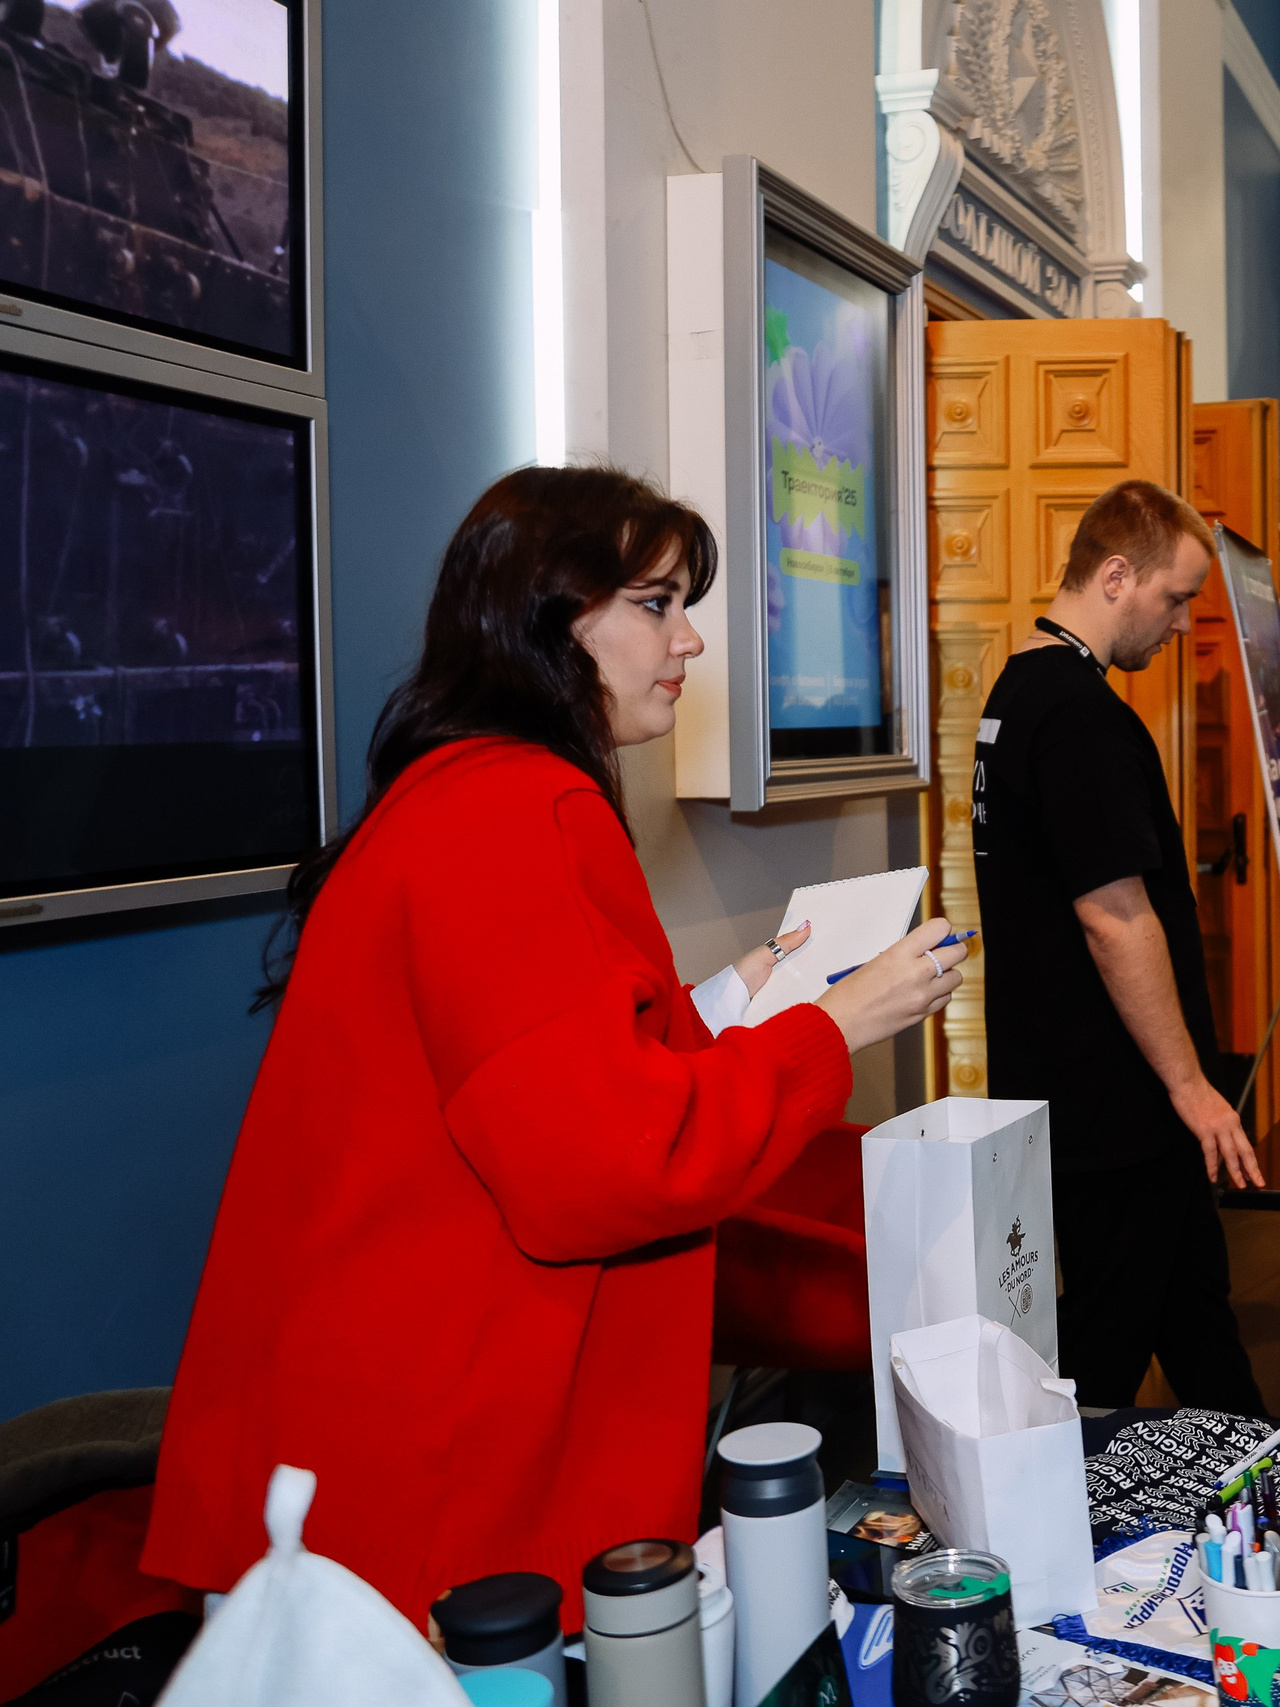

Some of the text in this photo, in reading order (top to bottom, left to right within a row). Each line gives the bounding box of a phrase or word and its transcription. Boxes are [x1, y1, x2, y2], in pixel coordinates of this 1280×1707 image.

[998, 1250, 1038, 1288] LES AMOURS
[1085, 1461, 1135, 1490] REGIO
